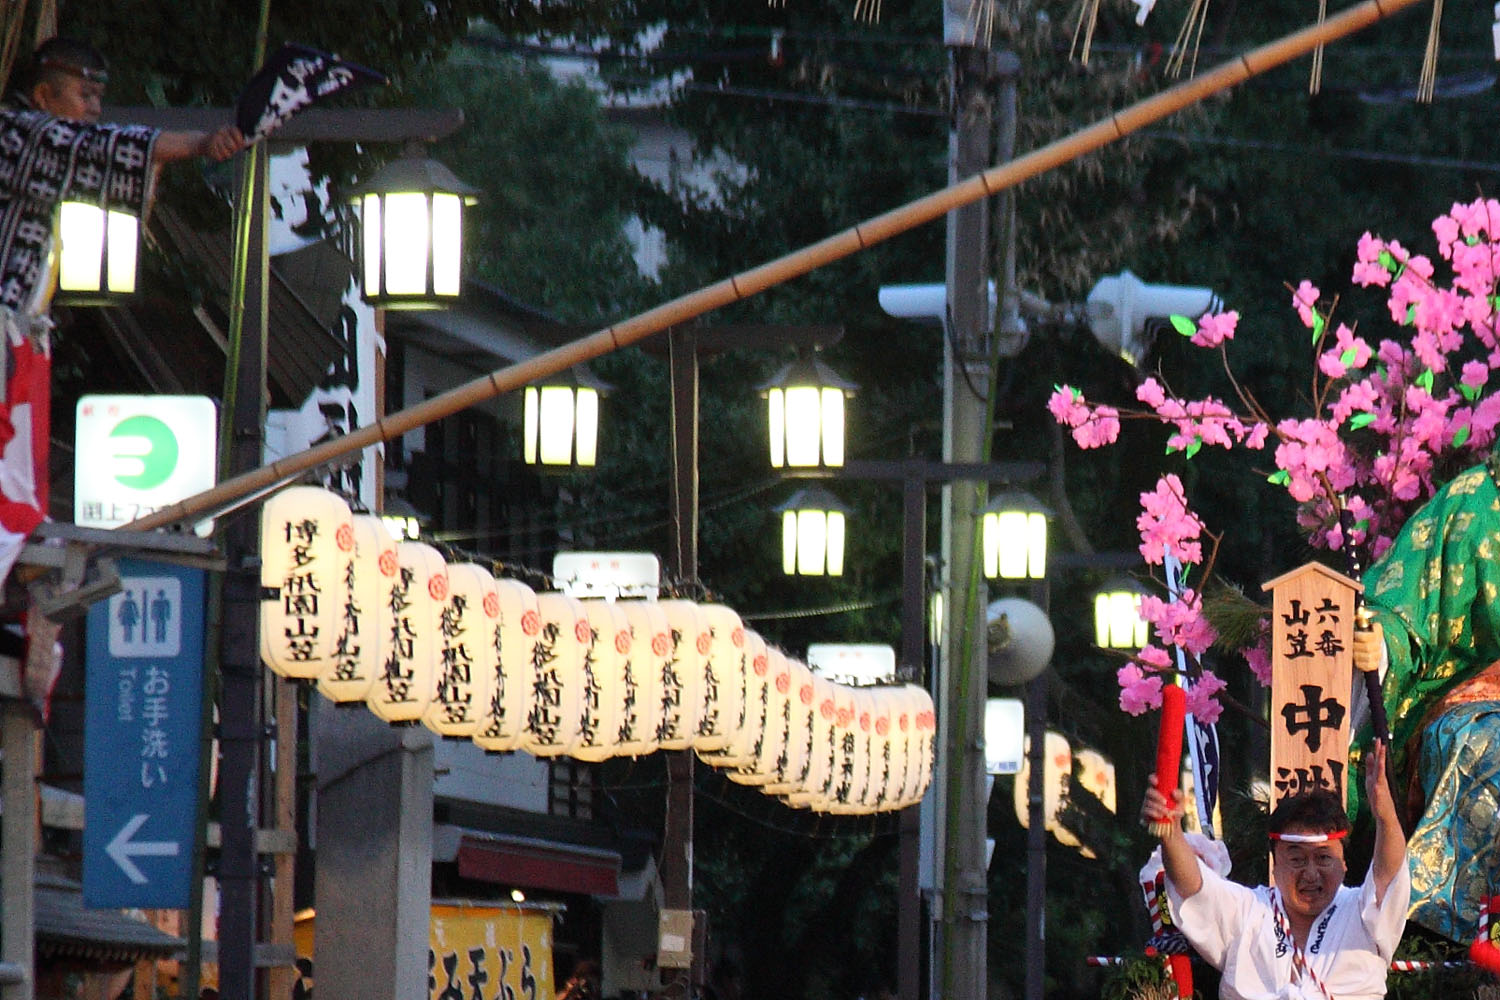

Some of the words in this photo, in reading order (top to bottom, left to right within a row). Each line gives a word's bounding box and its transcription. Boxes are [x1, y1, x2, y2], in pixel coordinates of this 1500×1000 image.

[1281, 600, 1316, 660] 山笠
[1314, 598, 1346, 657] 六番
[118, 667, 138, 721] Toilet
[142, 665, 169, 788] お手洗い
